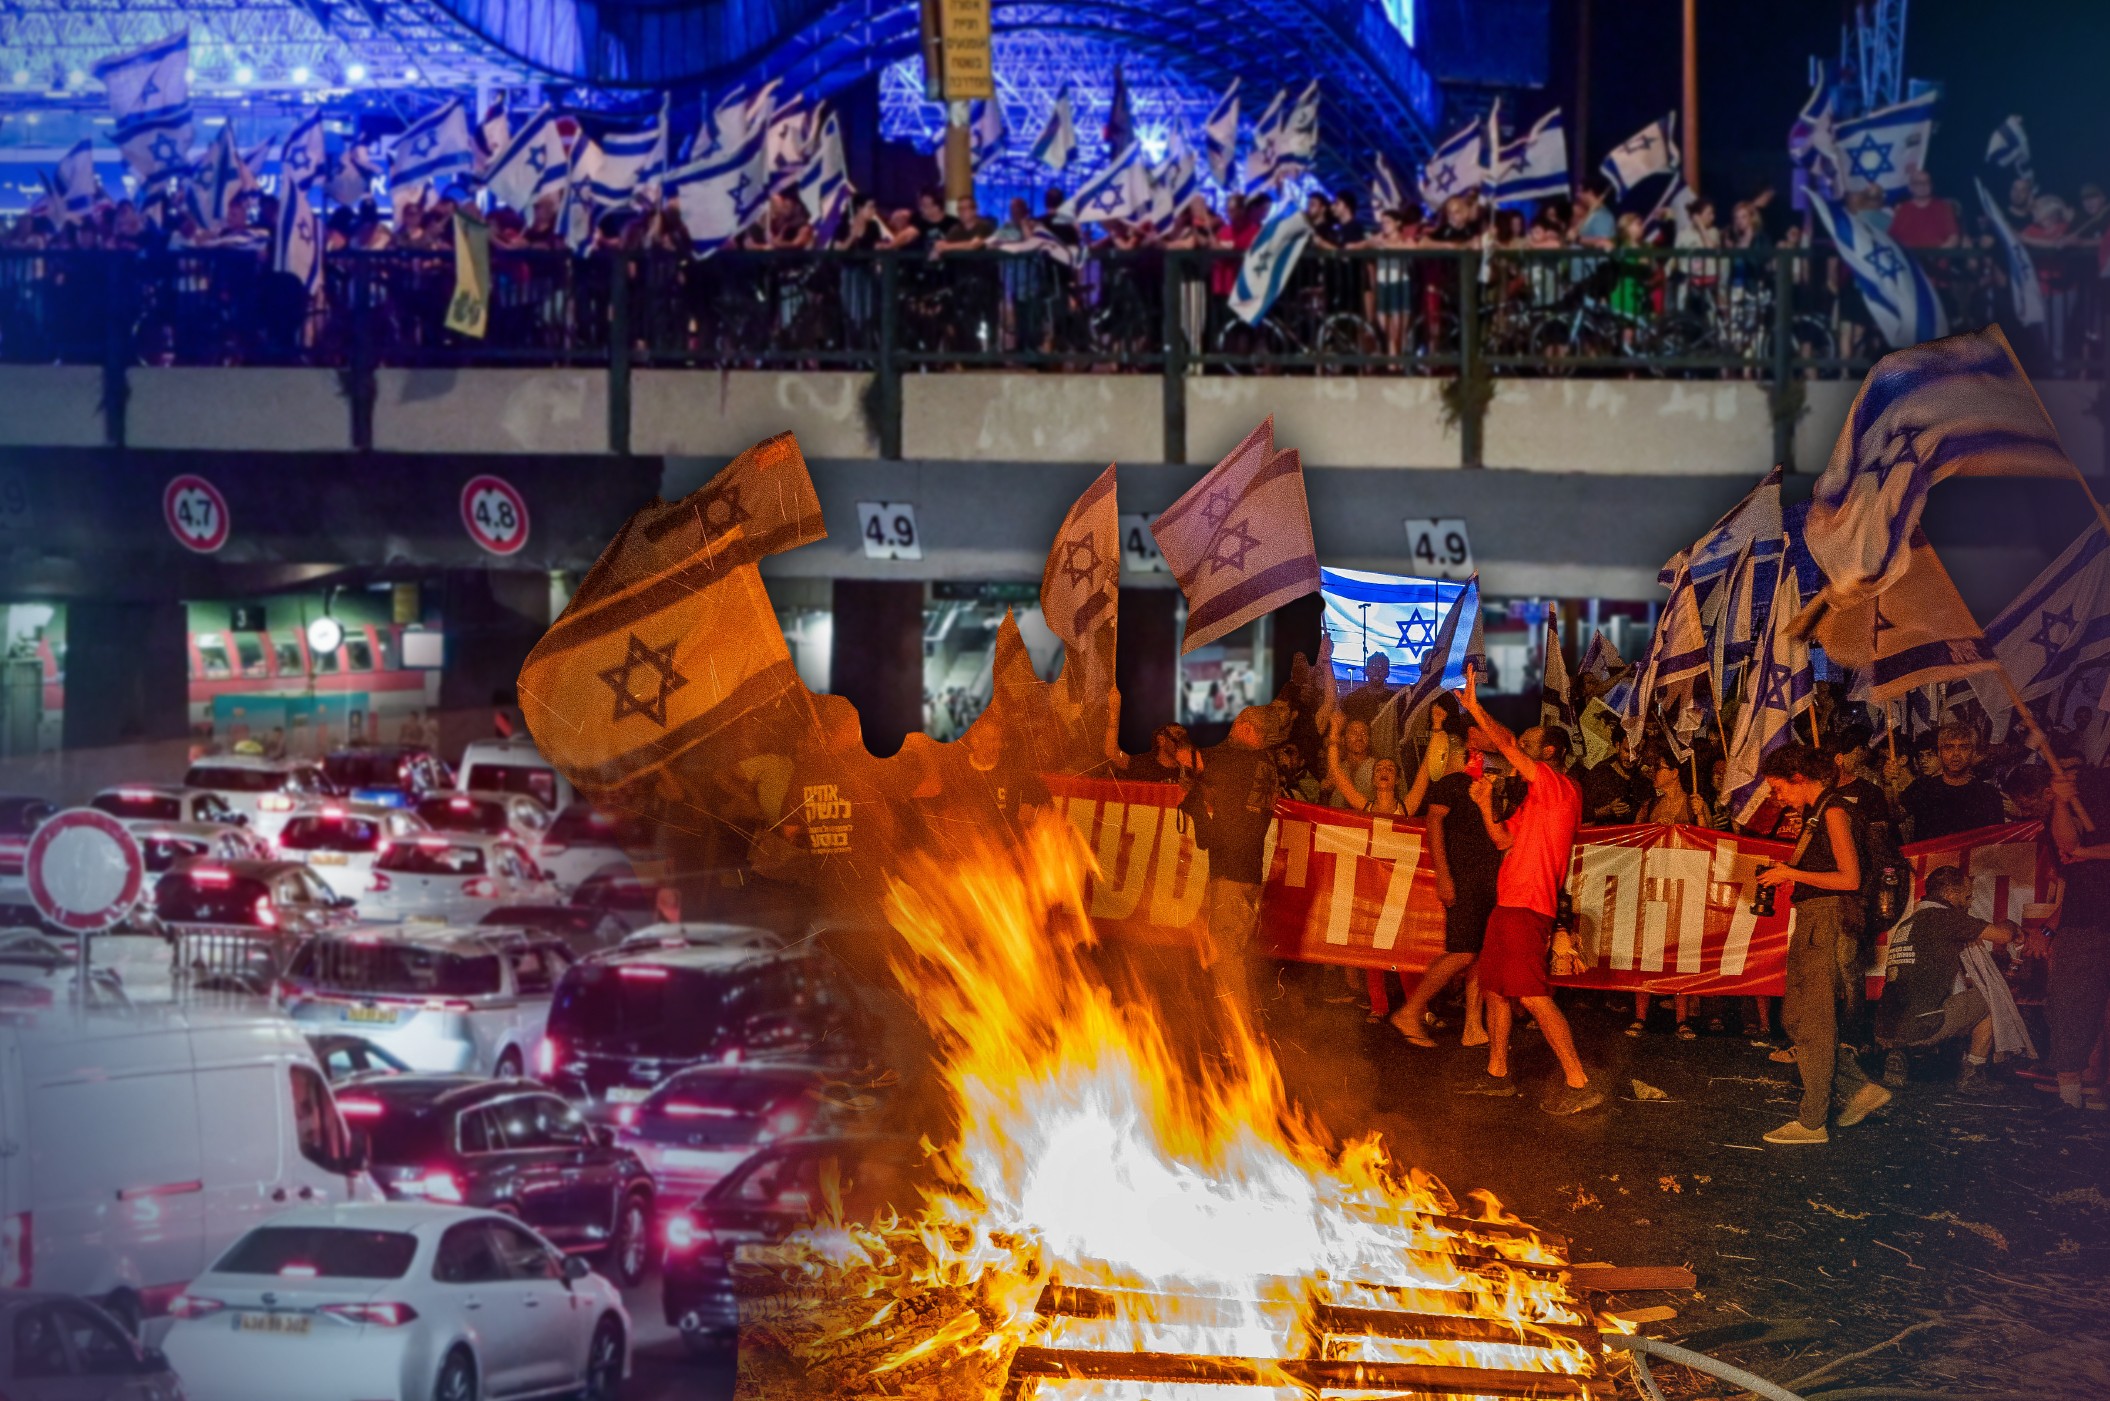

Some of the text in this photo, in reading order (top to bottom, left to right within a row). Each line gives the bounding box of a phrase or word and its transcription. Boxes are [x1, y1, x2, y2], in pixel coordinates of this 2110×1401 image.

[178, 498, 214, 529] 4.7
[475, 498, 517, 532] 4.8
[865, 515, 916, 548] 4.9
[1126, 527, 1158, 558] 4.
[1414, 533, 1467, 566] 4.9
[803, 784, 839, 803] אחים
[805, 798, 852, 823] לנשק
